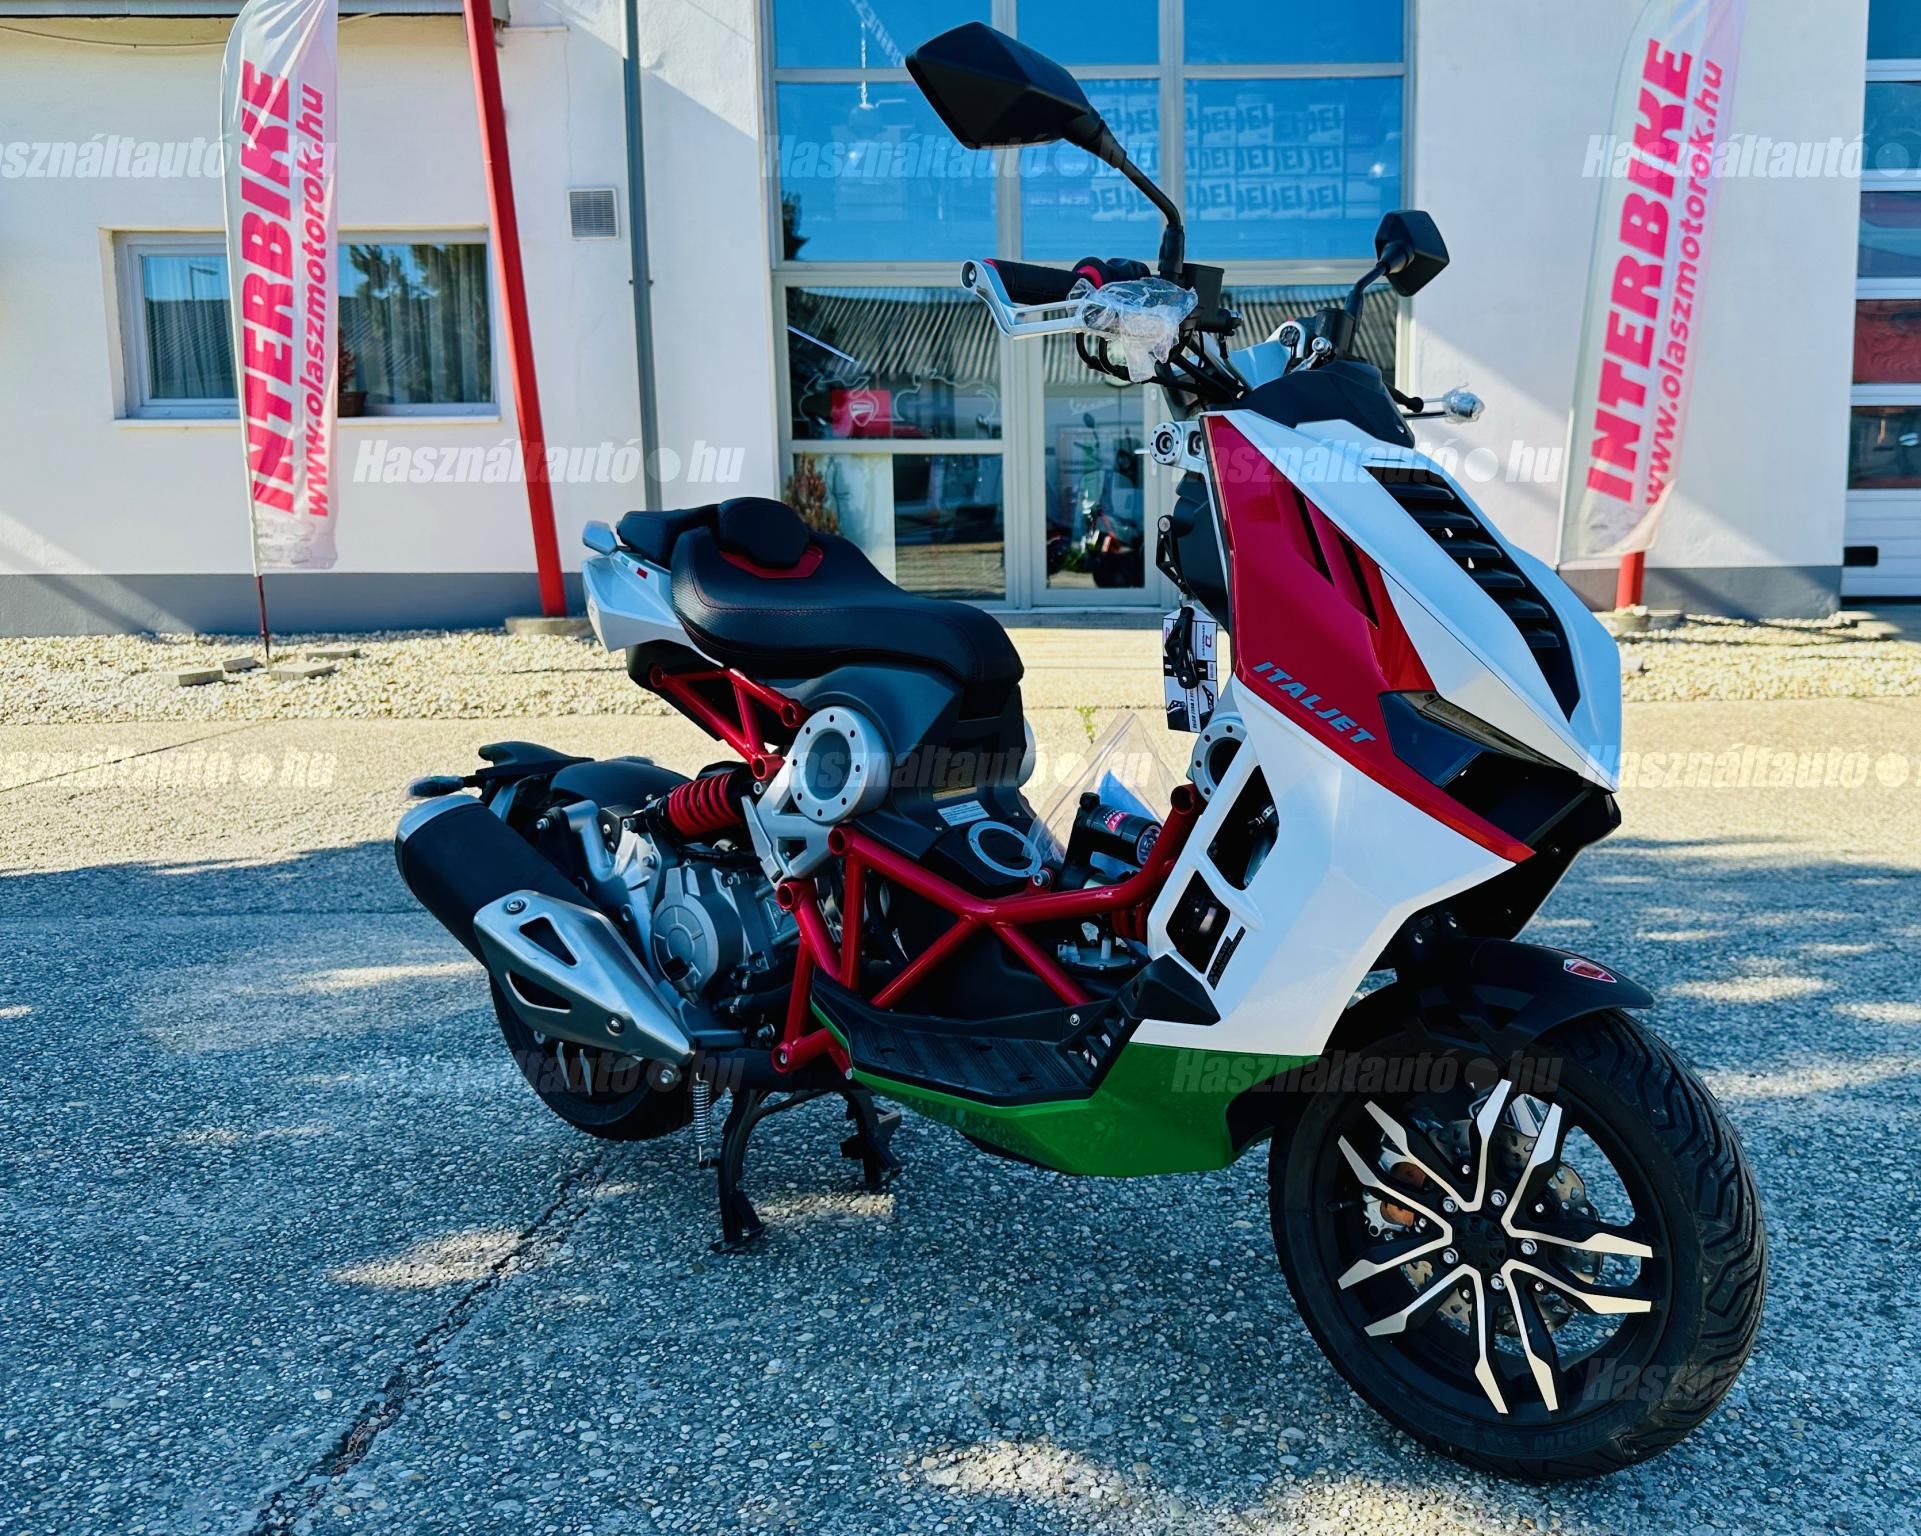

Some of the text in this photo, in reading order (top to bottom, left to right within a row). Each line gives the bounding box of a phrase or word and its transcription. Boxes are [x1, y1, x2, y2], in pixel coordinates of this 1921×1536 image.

[240, 59, 295, 513] INTERBIKE
[296, 83, 329, 517] www.olaszmotorok.hu
[1587, 38, 1692, 503] INTERBIKE
[1646, 60, 1723, 505] www.olaszmotorok.hu
[1253, 661, 1377, 743] ITALJET
